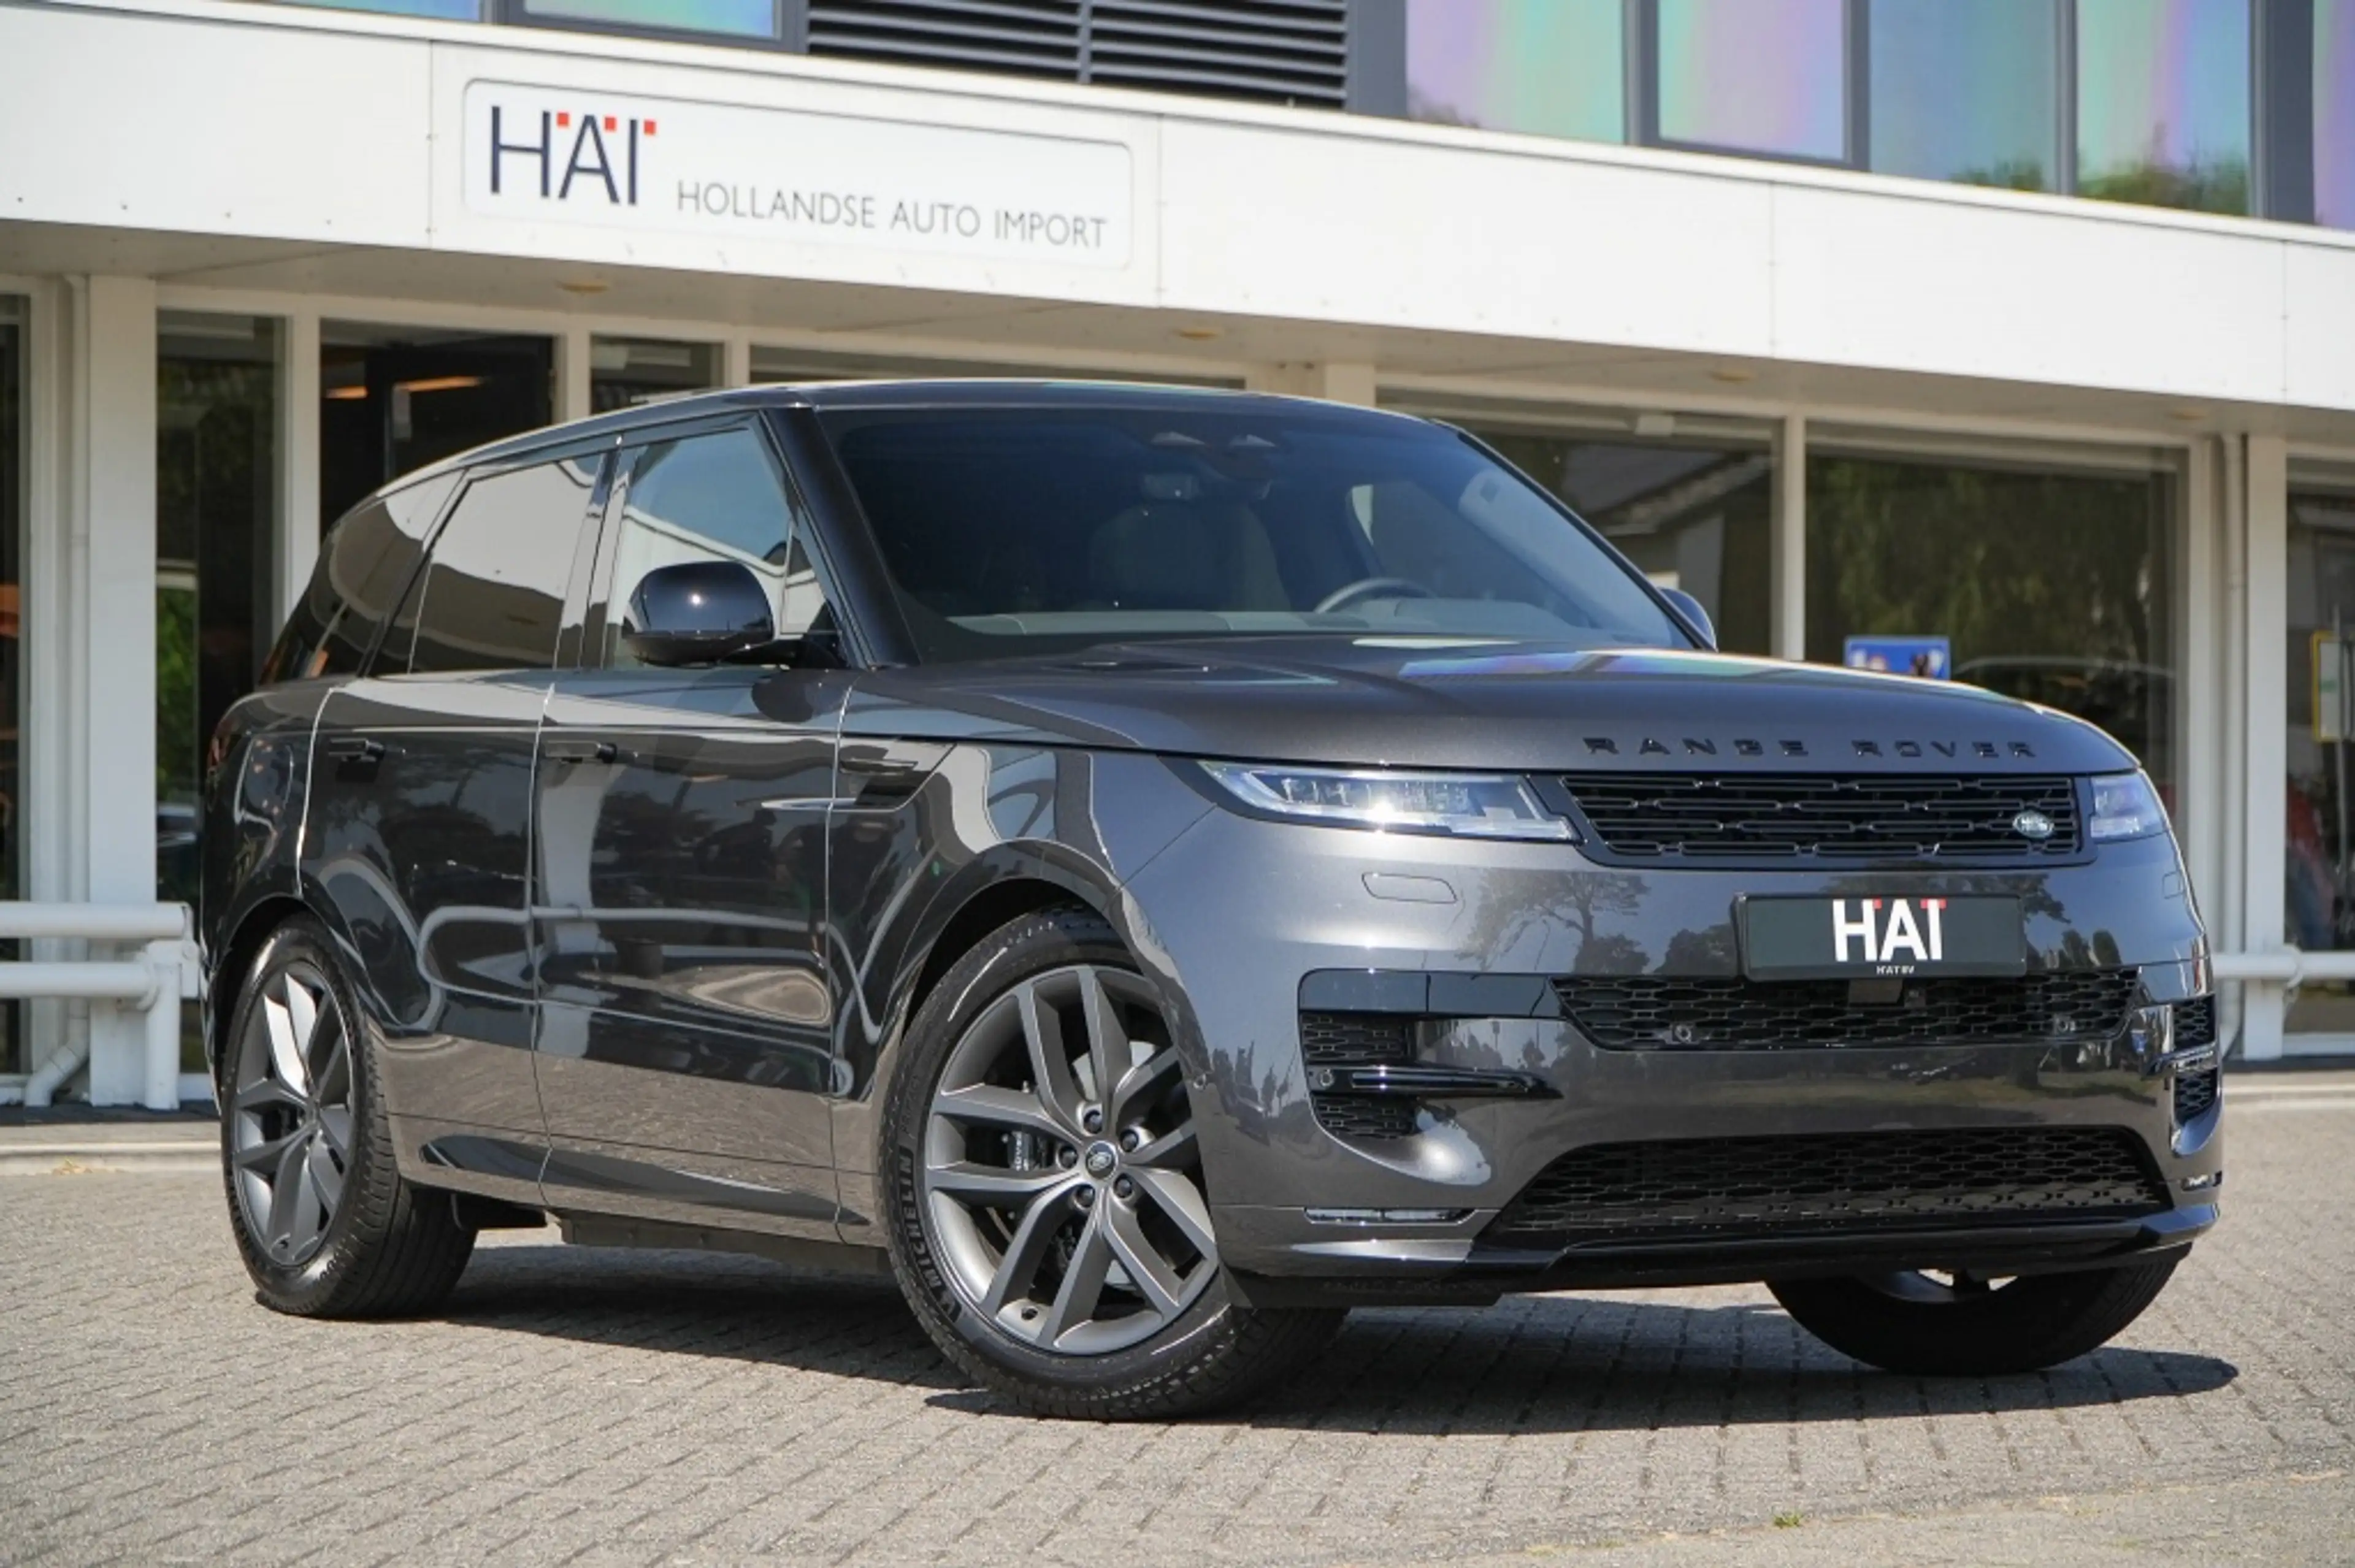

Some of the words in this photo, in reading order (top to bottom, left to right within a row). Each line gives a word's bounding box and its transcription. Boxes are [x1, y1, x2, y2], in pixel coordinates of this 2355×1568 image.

[678, 180, 876, 229] HOLLANDSE
[889, 201, 981, 238] AUTO
[994, 209, 1107, 248] IMPORT
[1582, 737, 1809, 757] RANGE
[1851, 740, 2037, 758] ROVER
[898, 1155, 942, 1289] MICHELIN
